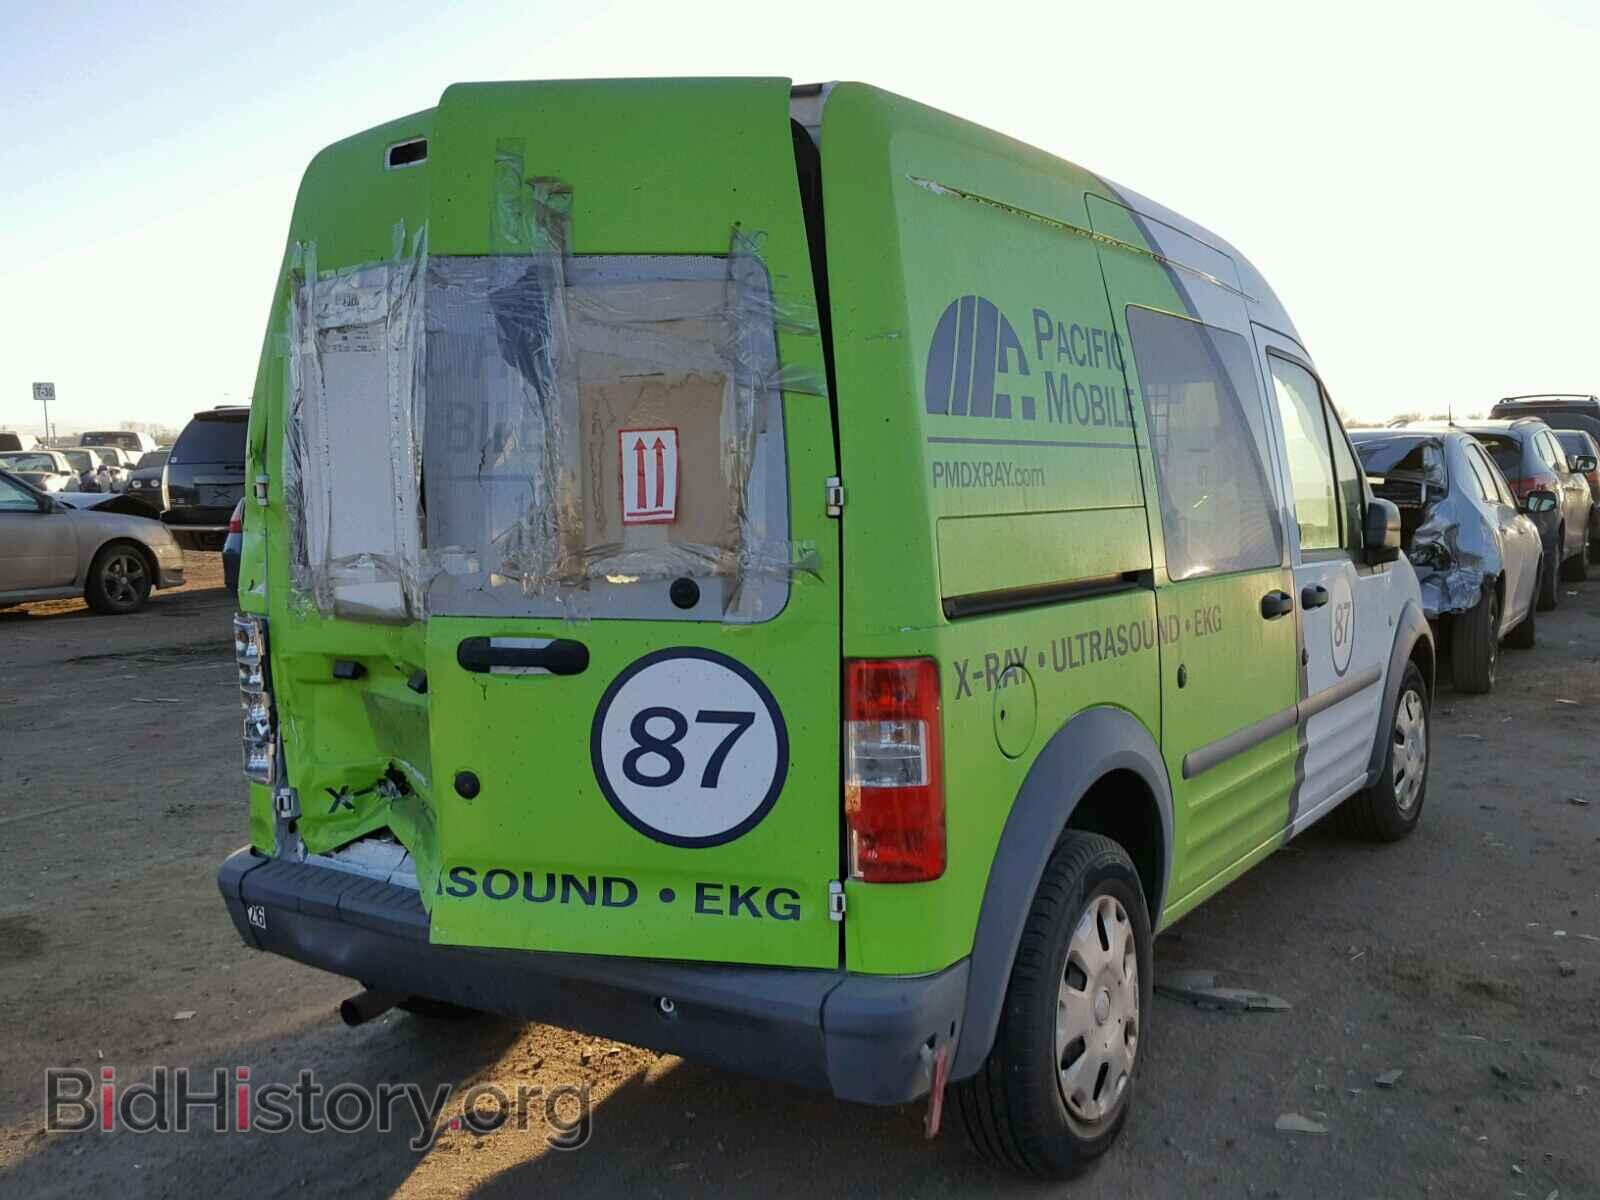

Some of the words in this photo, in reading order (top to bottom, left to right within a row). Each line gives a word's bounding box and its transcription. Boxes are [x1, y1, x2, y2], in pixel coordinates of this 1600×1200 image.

[1033, 308, 1127, 373] PACIFIC
[1045, 371, 1139, 429] MOBILE
[932, 461, 1046, 489] PMDXRAY.com
[953, 646, 1028, 700] X-RAY
[1052, 614, 1181, 672] ULTRASOUND
[1194, 605, 1222, 637] EKG
[1334, 601, 1351, 647] 87
[622, 706, 756, 789] 87
[694, 882, 801, 921] EKG
